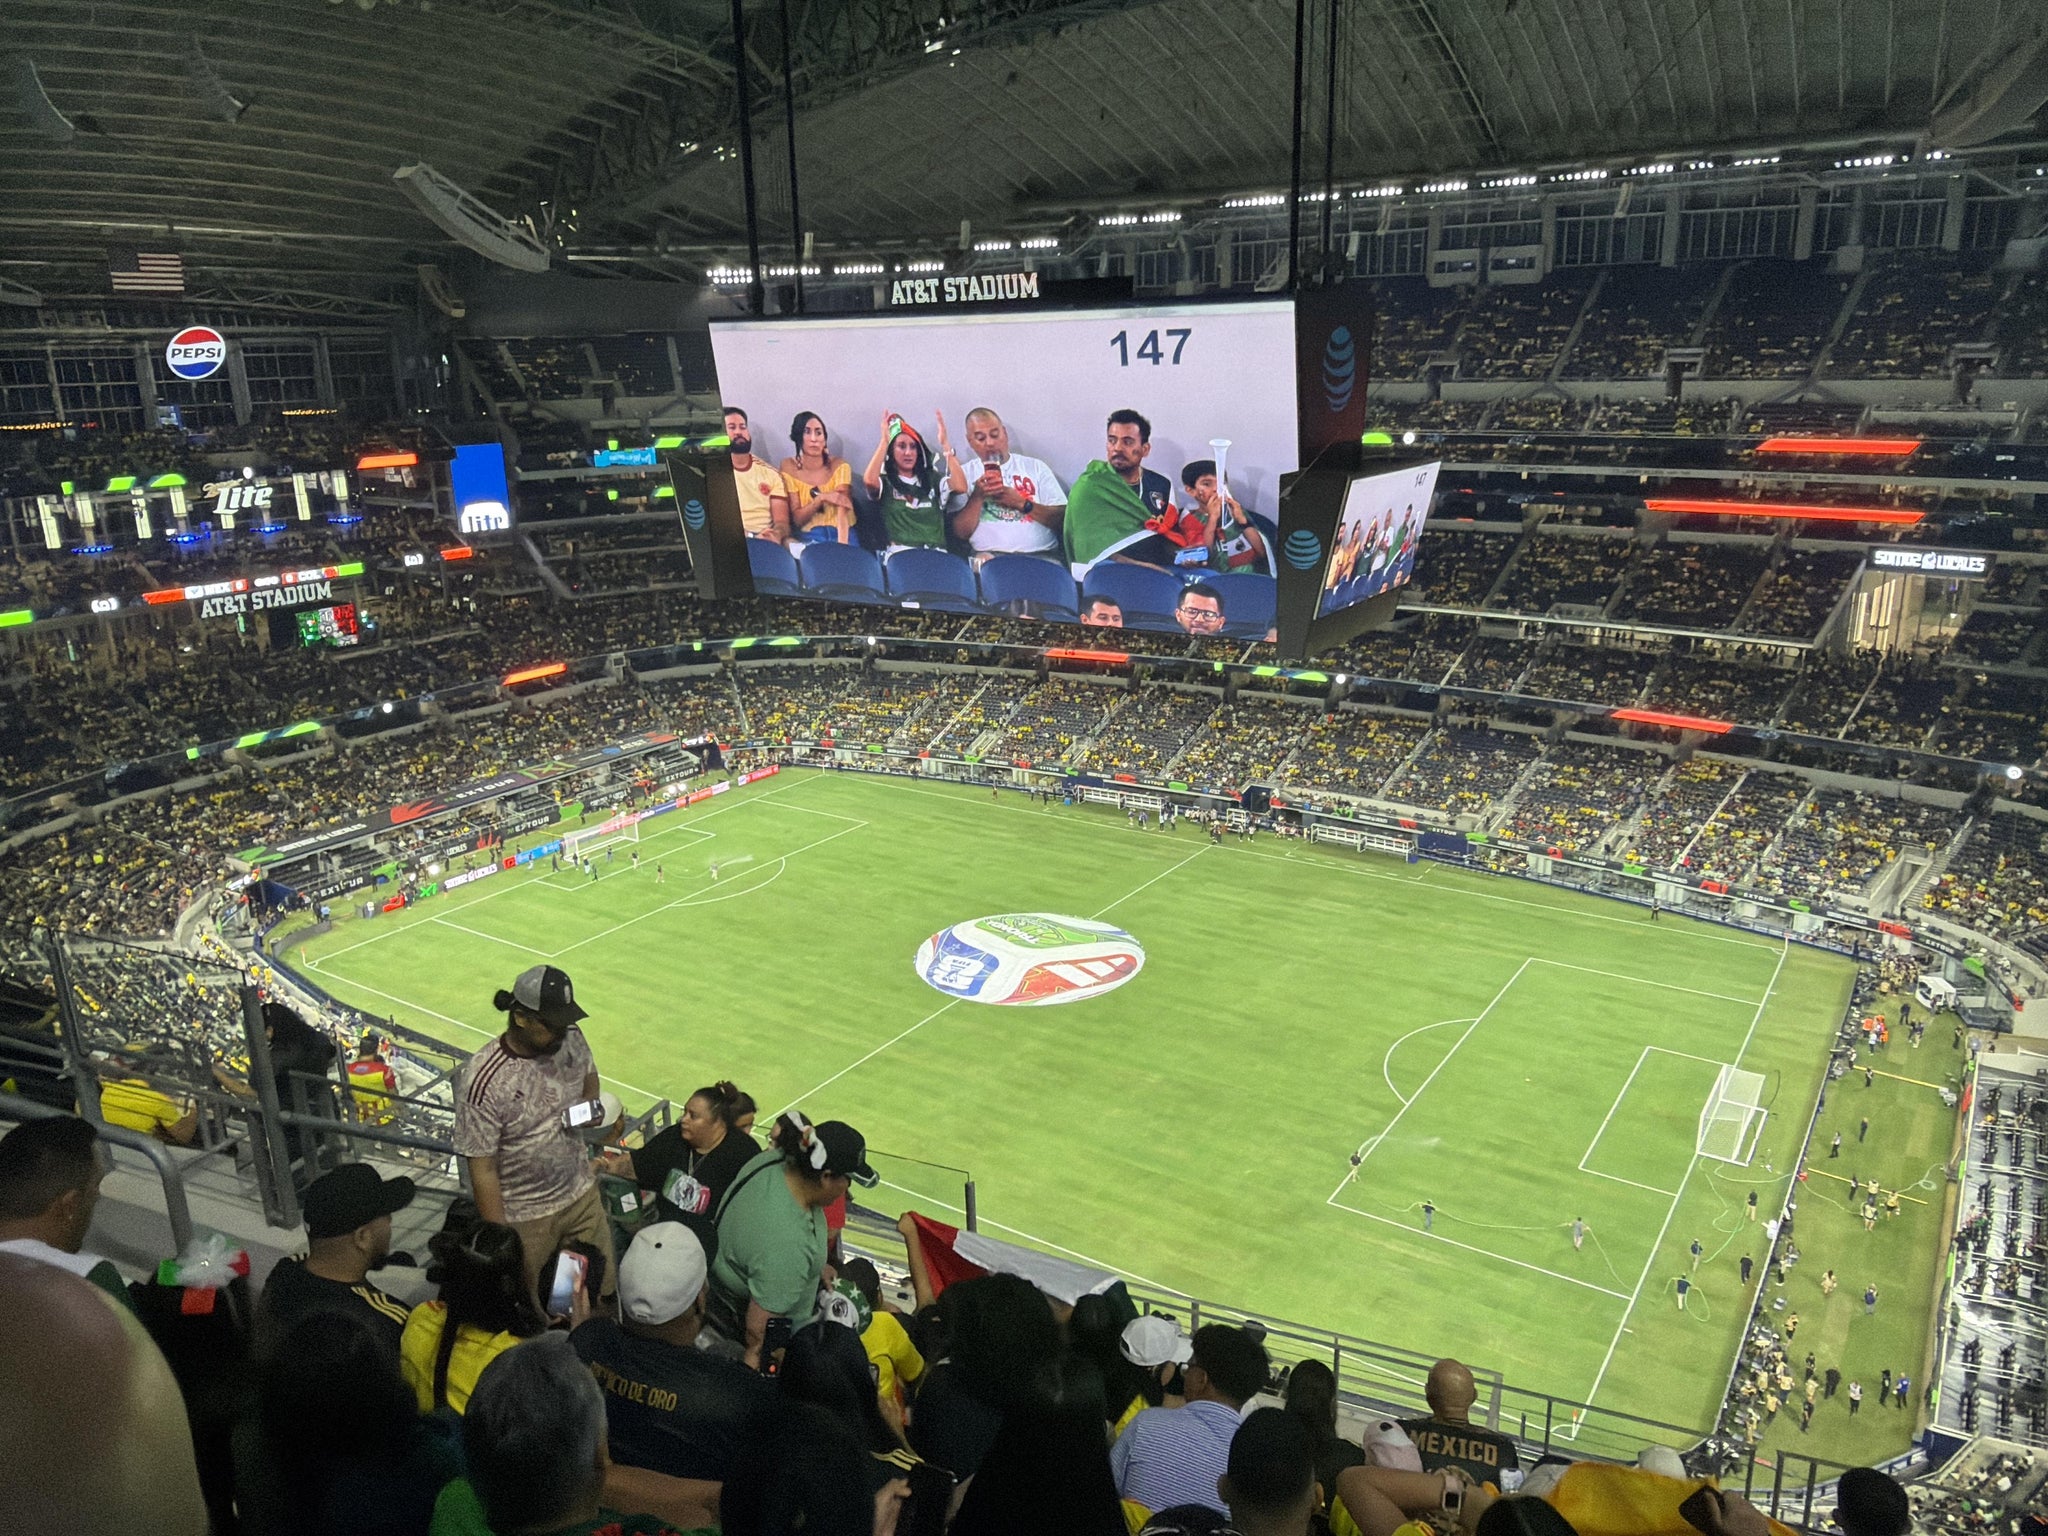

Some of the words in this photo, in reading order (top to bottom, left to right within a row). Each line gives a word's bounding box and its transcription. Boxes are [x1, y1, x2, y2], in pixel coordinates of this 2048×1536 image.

[891, 278, 939, 305] AT&T
[944, 272, 1039, 302] STADIUM
[171, 347, 222, 359] PEPSI
[1110, 328, 1192, 366] 147
[212, 486, 273, 515] Lite
[1936, 555, 1986, 572] LOCALES
[201, 593, 248, 619] AT&T
[251, 581, 333, 610] STADIUM
[628, 1381, 648, 1403] DE
[648, 1387, 678, 1412] ORO
[1409, 1429, 1498, 1467] MEXICO
